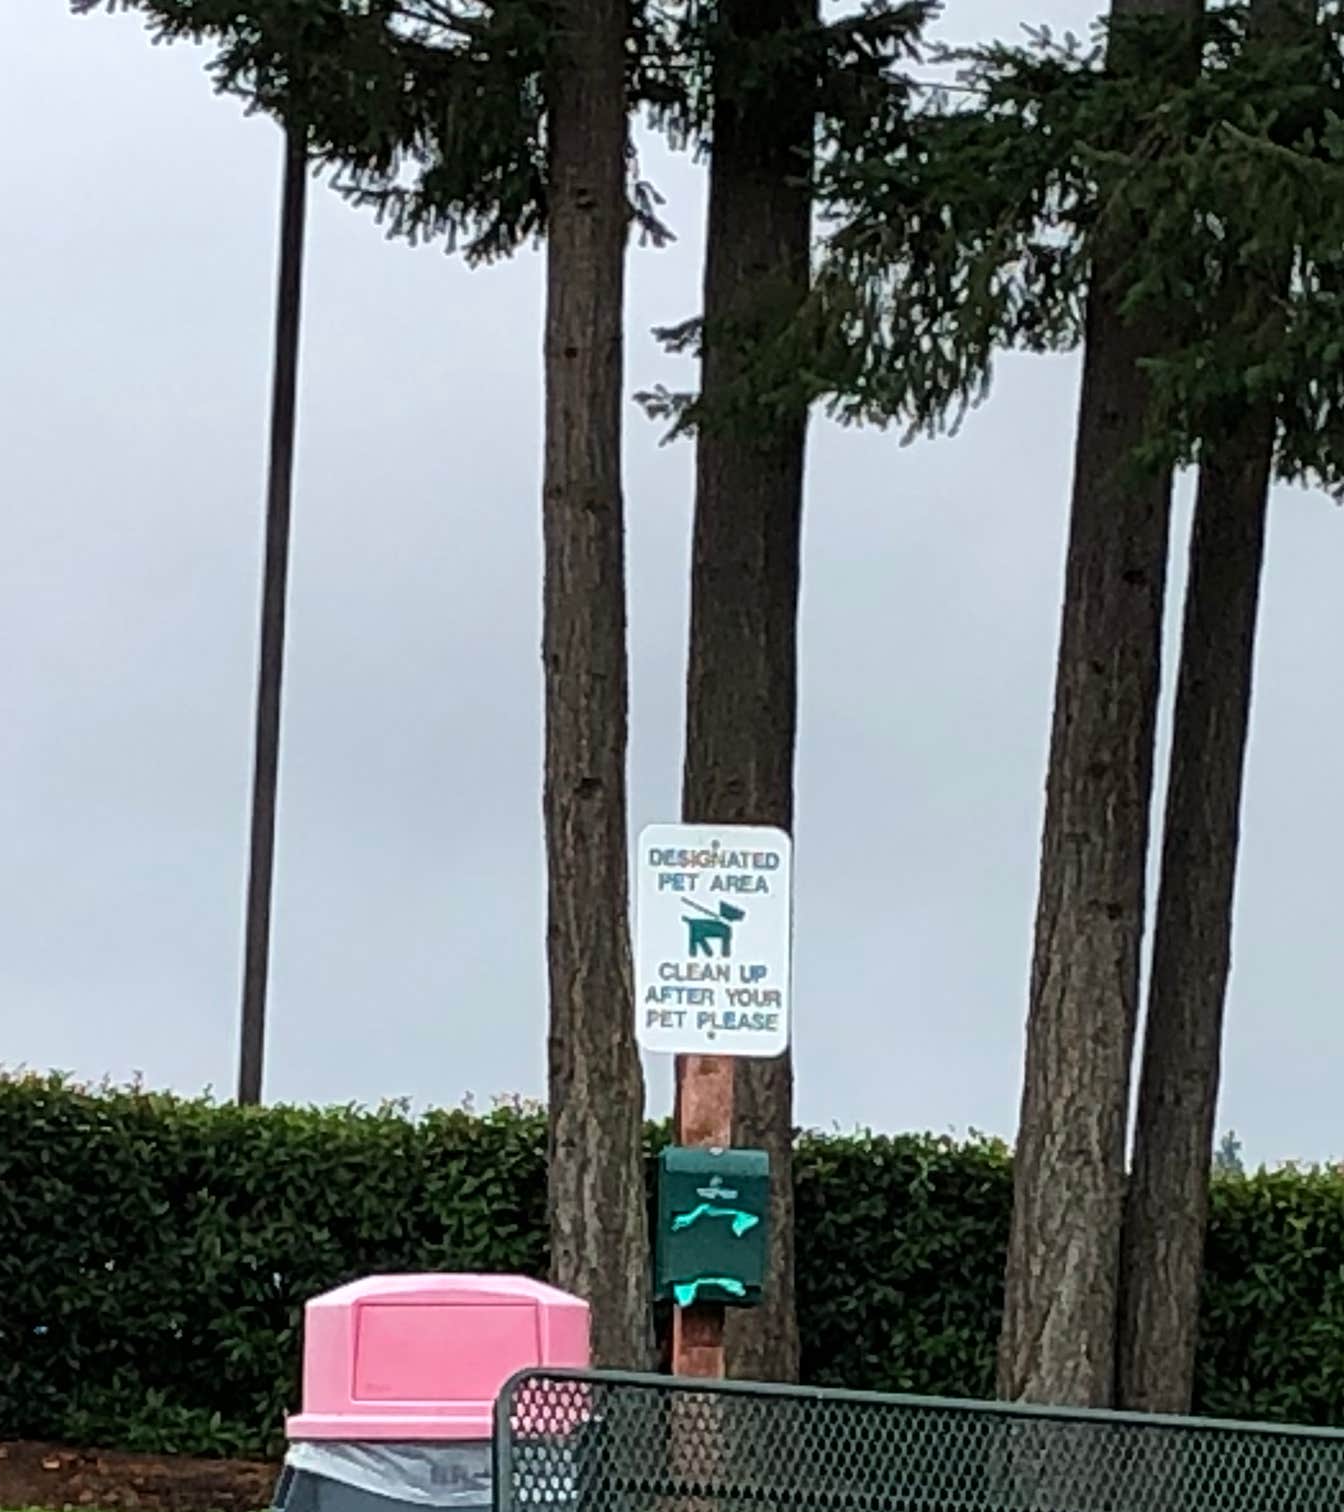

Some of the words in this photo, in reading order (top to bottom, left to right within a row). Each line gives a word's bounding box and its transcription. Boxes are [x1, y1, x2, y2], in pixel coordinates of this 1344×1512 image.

[649, 848, 780, 871] DESIGNATED
[658, 873, 699, 891] PET
[709, 874, 769, 893] AREA
[659, 962, 731, 982] CLEAN
[739, 965, 768, 983] UP
[645, 985, 716, 1006] AFTER
[725, 988, 782, 1008] YOUR
[646, 1009, 687, 1028] PET
[697, 1011, 779, 1032] PLEASE
